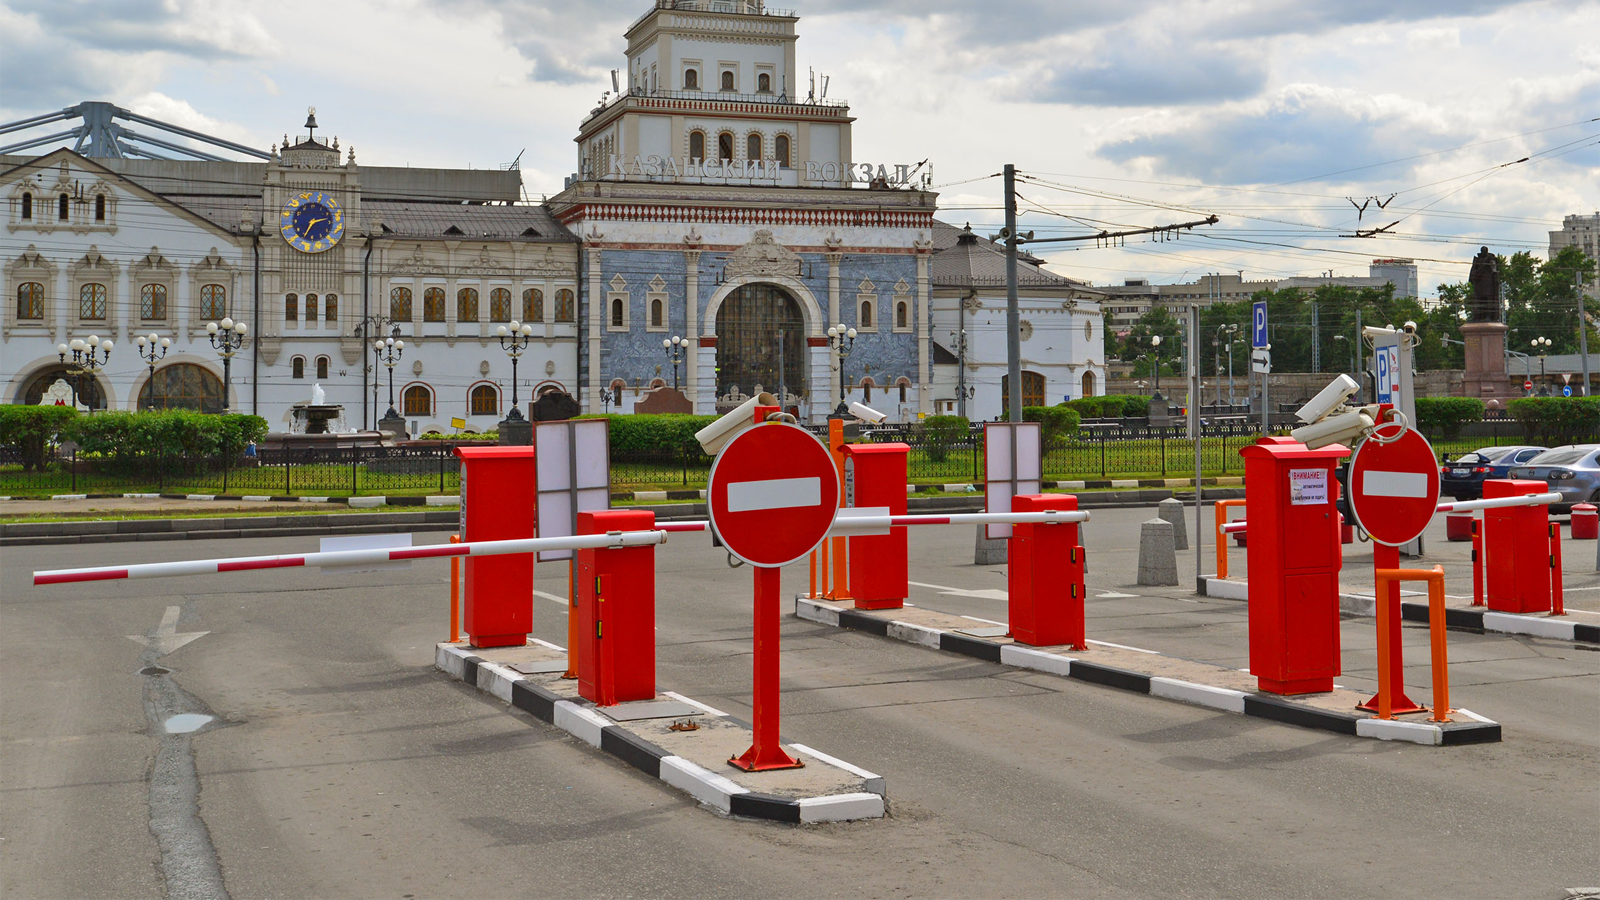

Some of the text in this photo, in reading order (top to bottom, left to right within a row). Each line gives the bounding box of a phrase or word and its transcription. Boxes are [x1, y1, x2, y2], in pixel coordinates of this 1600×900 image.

[608, 153, 909, 185] КАЗАНСКИЙ ВОКЗАЛ
[1256, 307, 1265, 343] P
[1379, 354, 1387, 391] P
